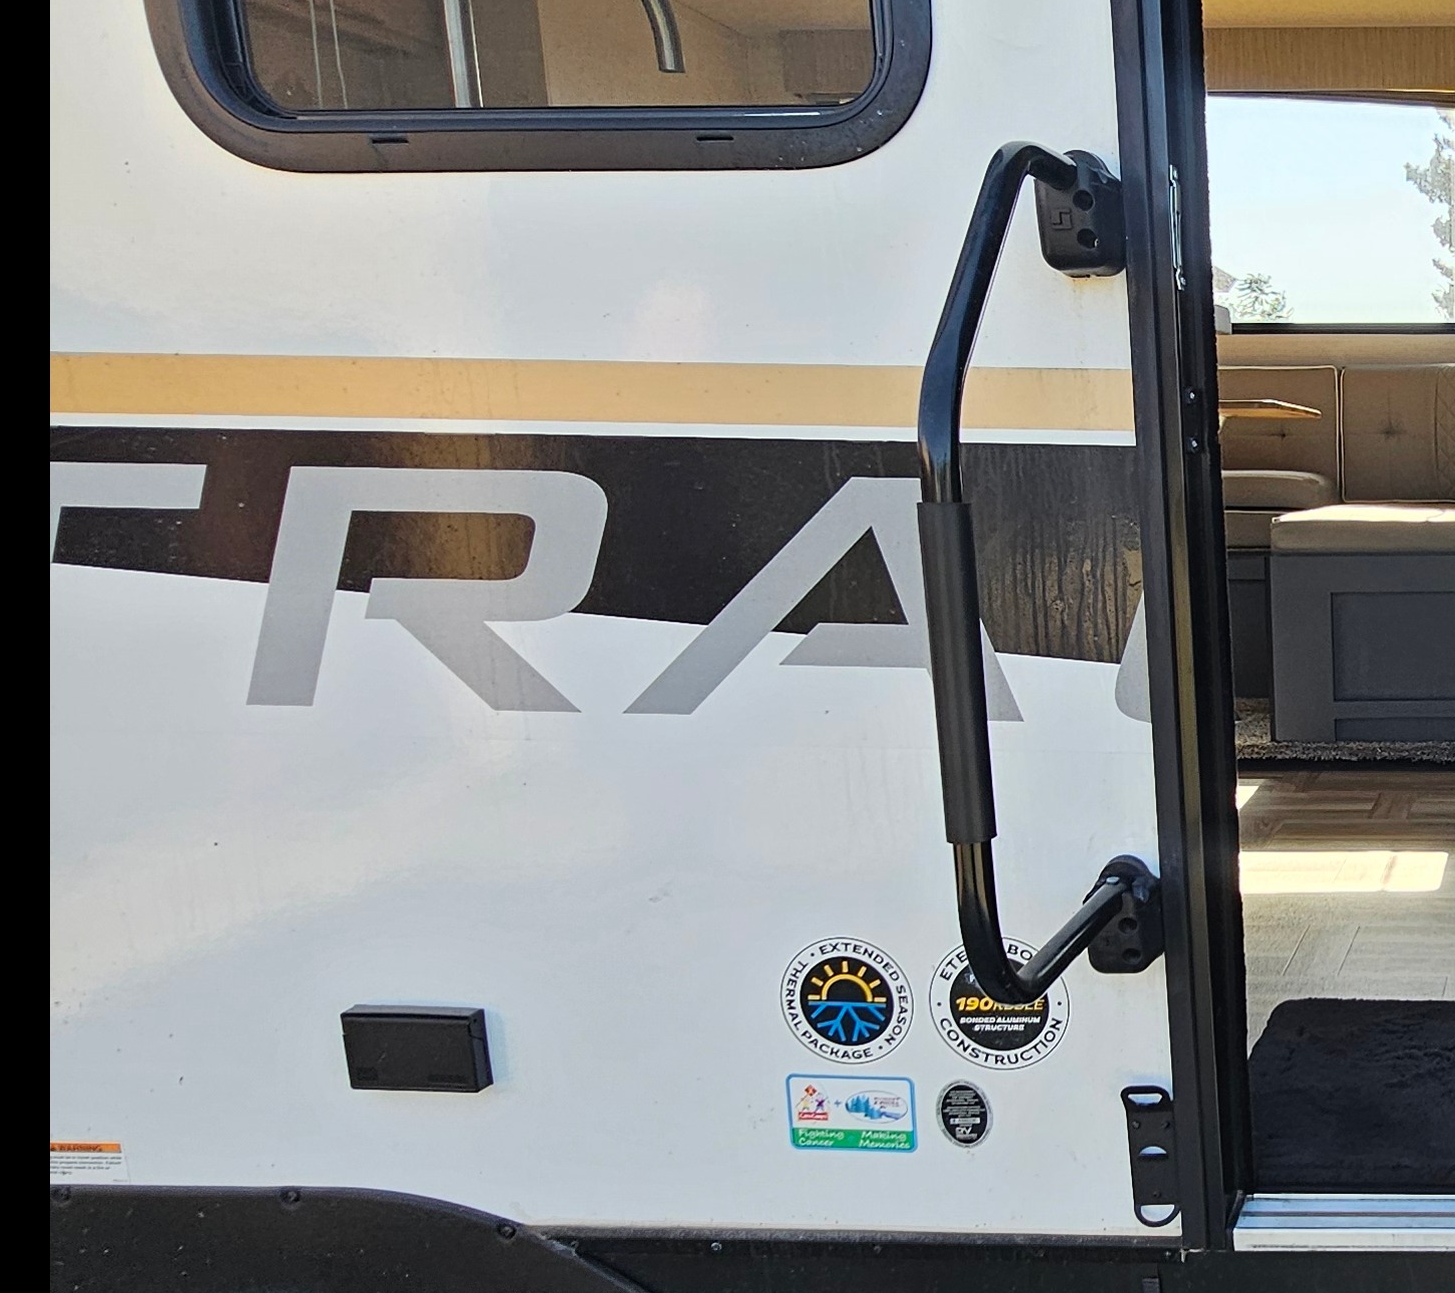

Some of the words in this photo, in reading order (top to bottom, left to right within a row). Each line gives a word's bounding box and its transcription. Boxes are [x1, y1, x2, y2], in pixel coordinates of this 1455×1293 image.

[819, 942, 900, 981] EXTENDED
[884, 985, 908, 1045] SEASON
[785, 961, 809, 1031] THERMAL
[801, 1030, 873, 1060] PACKAGE
[996, 1016, 1041, 1024] ALUMINUM
[974, 1024, 1025, 1032] STRUCTURE
[940, 1018, 1062, 1066] CONSTRUCTION
[798, 1129, 845, 1140] Fighting
[861, 1131, 907, 1141] Making
[798, 1137, 835, 1146] Cancer
[858, 1139, 911, 1149] Memories
